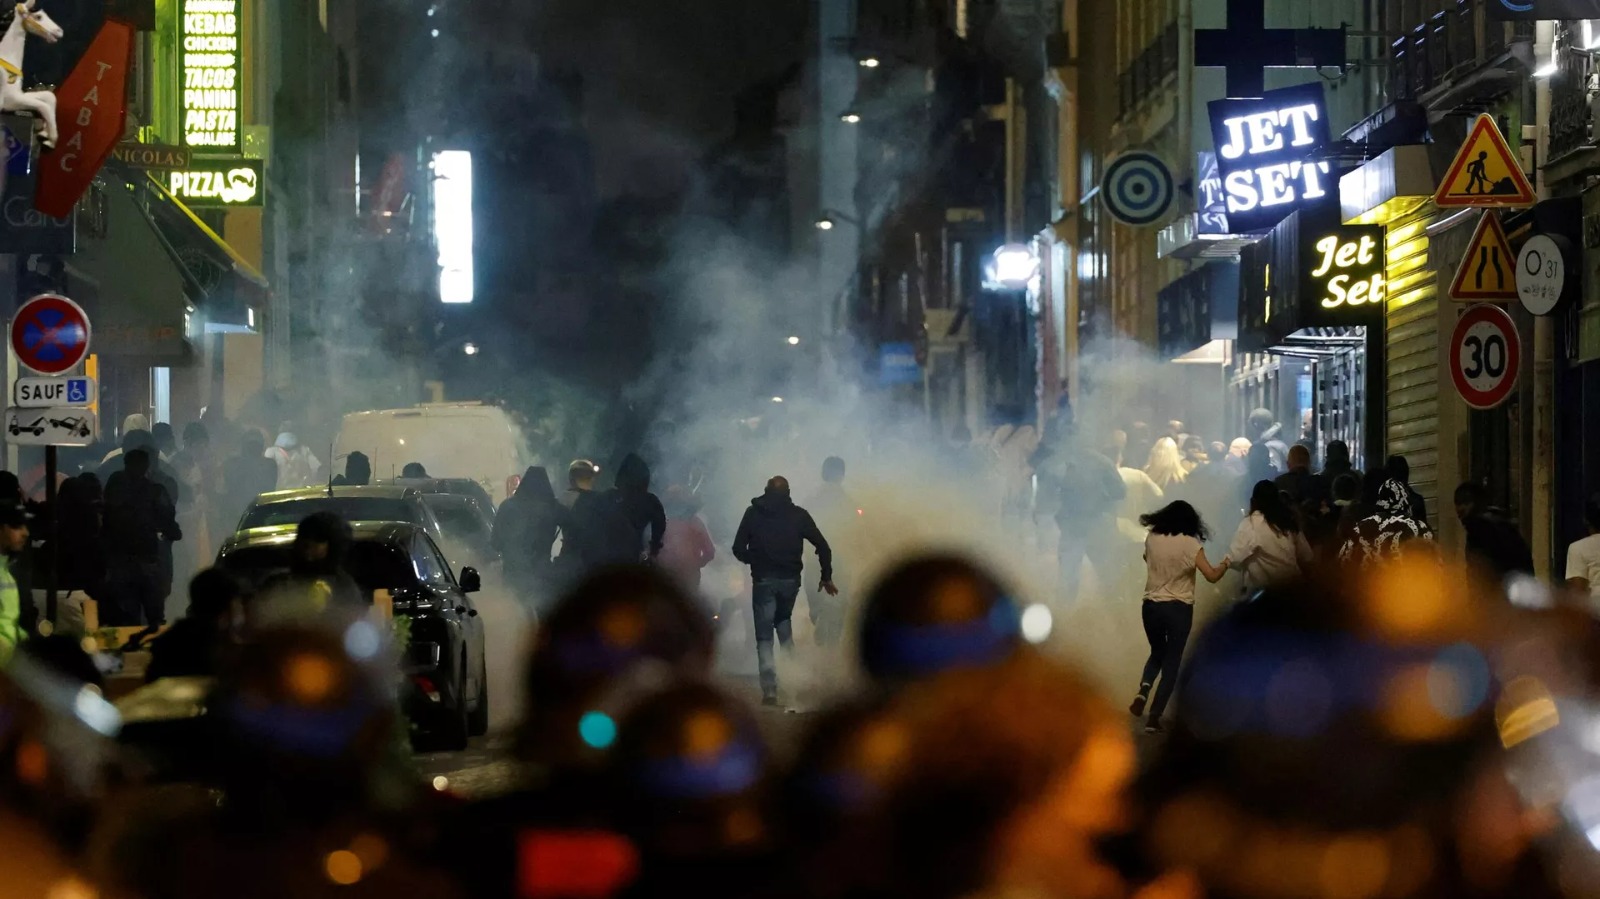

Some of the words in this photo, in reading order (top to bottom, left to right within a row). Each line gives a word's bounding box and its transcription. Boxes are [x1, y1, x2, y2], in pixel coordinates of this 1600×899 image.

[184, 14, 236, 34] KEBAB
[184, 37, 236, 51] CHICKEN
[184, 68, 236, 88] TACOS
[184, 90, 236, 109] PANINI
[60, 61, 111, 172] TABAC
[185, 111, 236, 131] PASTA
[1221, 103, 1318, 159] JET
[112, 150, 184, 166] NICOLAS
[170, 172, 224, 197] PIZZA
[1225, 160, 1329, 213] SET
[1312, 235, 1375, 277] Jet
[1321, 274, 1384, 308] Set
[1464, 335, 1505, 379] 30
[21, 384, 65, 400] SAUF
